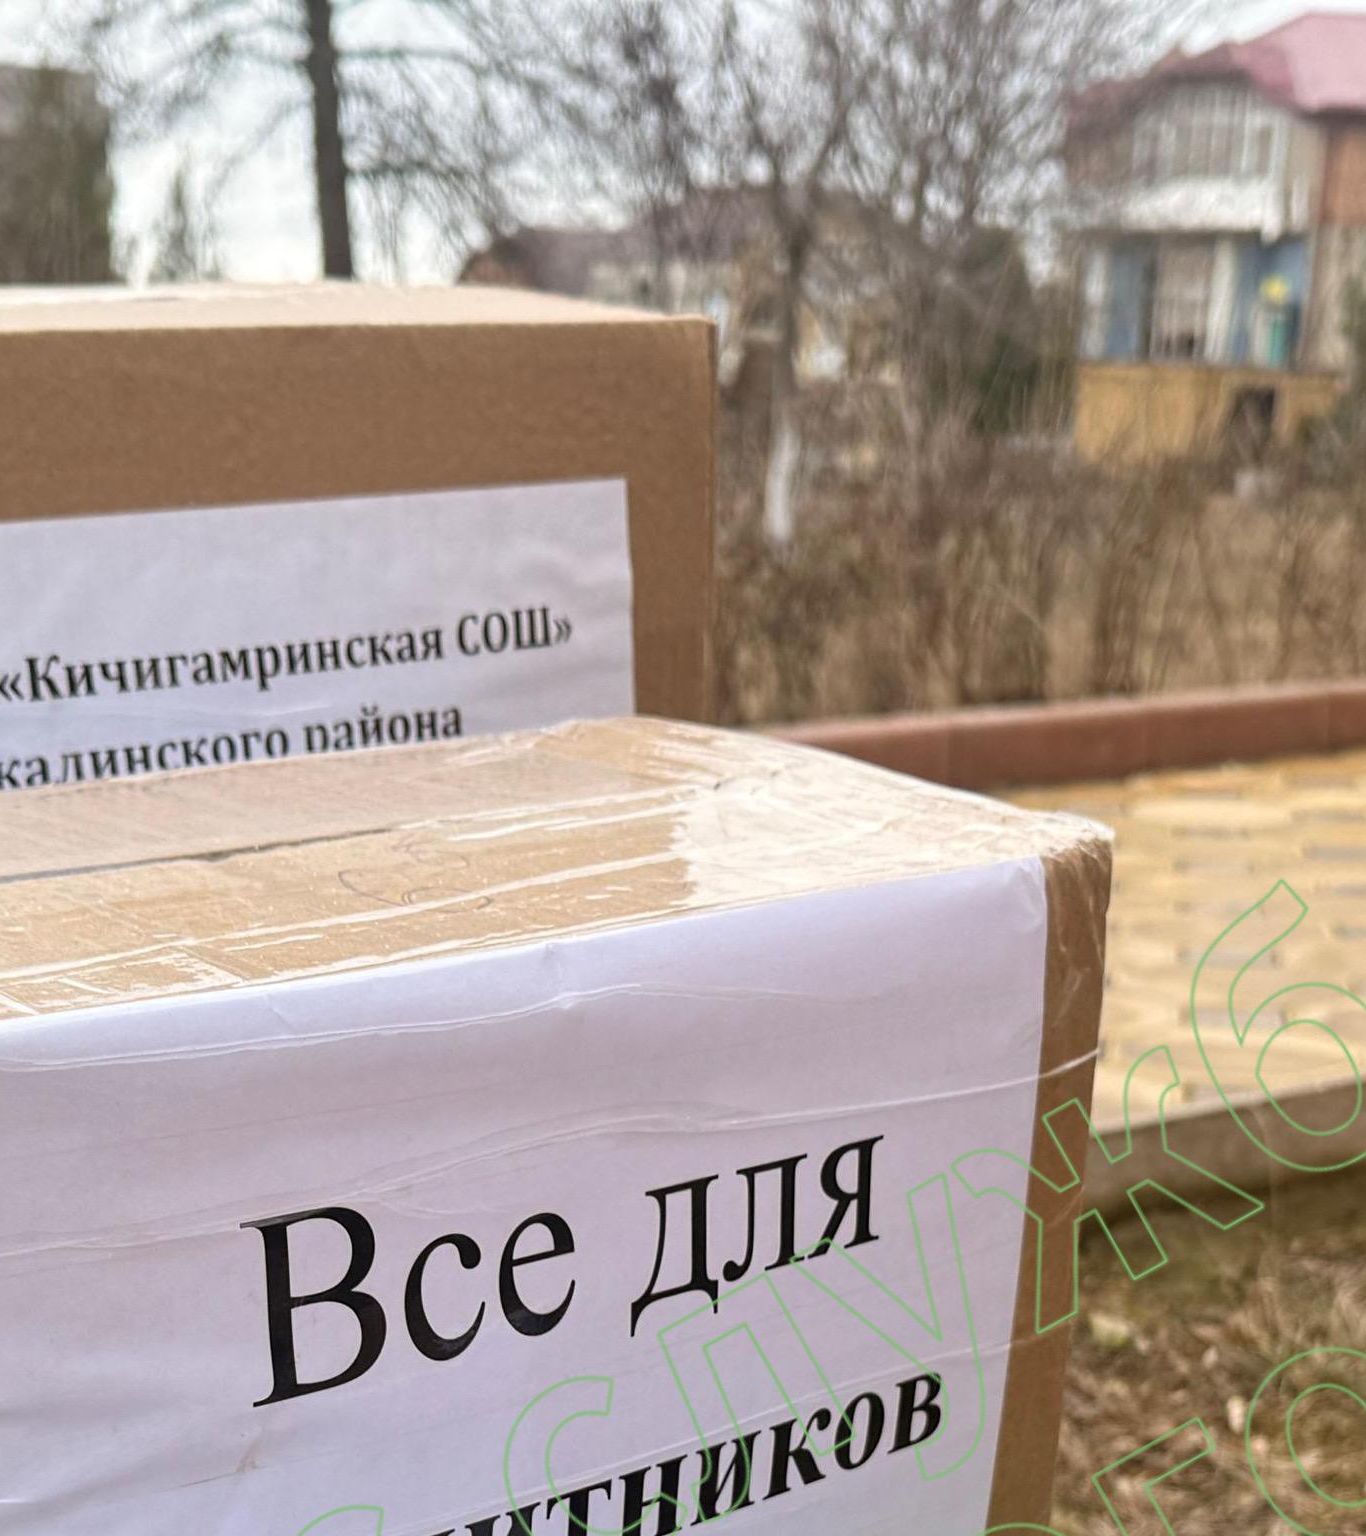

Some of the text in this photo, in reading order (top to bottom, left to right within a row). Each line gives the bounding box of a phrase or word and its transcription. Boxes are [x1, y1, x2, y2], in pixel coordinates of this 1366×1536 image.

[456, 603, 574, 657] СОШ»
[304, 702, 464, 754] района
[239, 1135, 886, 1408] Все для
